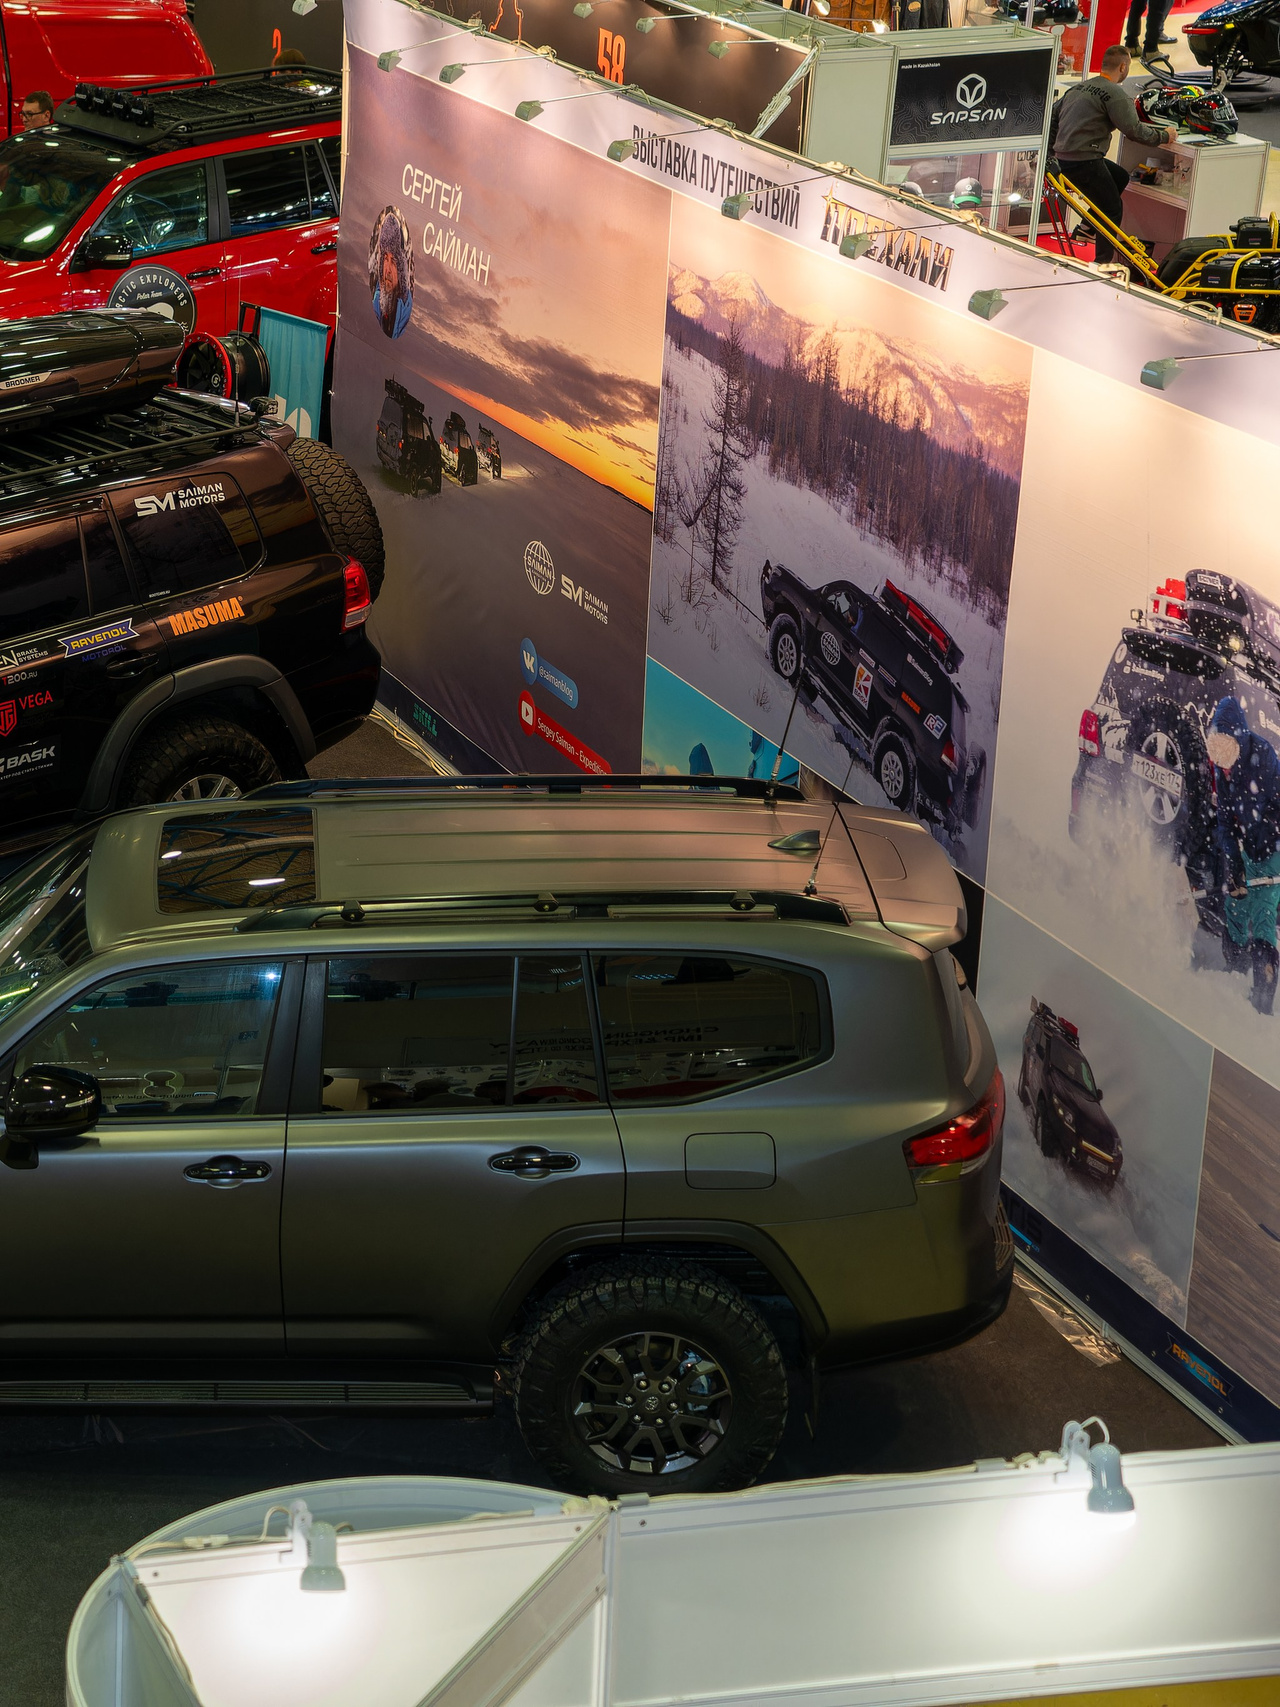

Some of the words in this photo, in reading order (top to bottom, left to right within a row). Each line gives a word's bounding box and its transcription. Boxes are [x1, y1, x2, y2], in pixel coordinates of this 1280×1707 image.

[930, 107, 1007, 125] SAPSAN
[402, 163, 463, 223] СЕРГЕЙ
[422, 222, 491, 286] САЙМАН
[115, 280, 137, 308] RCTIC
[139, 274, 188, 307] EXPLORERS
[5, 375, 41, 388] BROOMER
[178, 482, 224, 499] SAIMAN
[179, 492, 226, 509] MOTORS
[583, 601, 609, 625] MOTORS
[584, 590, 609, 614] SAIMAN
[168, 597, 245, 637] MASUMA
[70, 627, 128, 651] RAVENOL
[16, 647, 39, 658] BRAKE
[17, 650, 49, 663] SYSTEMS
[538, 665, 574, 701] @saimanblog
[18, 690, 54, 710] VEGA
[537, 717, 556, 742] Sergey
[555, 731, 575, 756] Saiman
[6, 745, 56, 770] BASK
[1171, 1342, 1228, 1397] RAVENOL
